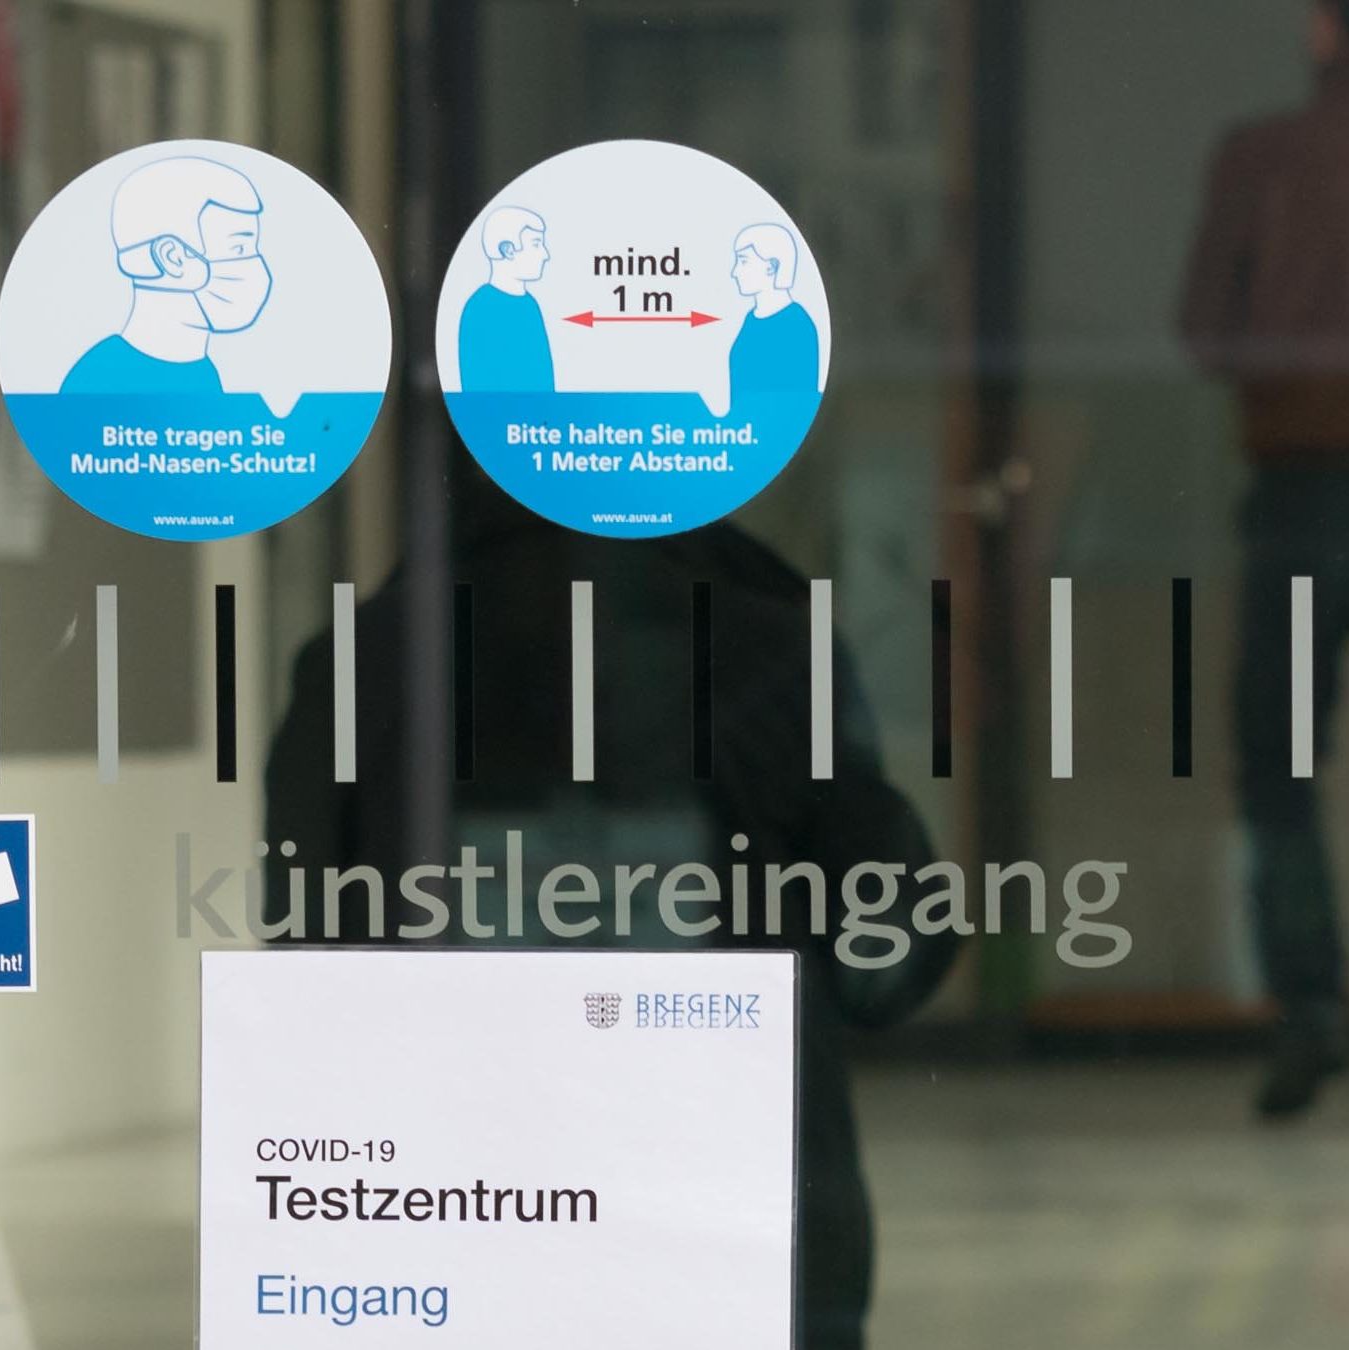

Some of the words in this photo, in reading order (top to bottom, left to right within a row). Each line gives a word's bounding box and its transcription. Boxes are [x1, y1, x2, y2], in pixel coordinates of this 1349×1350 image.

[593, 247, 692, 278] mind.
[612, 286, 628, 313] 1
[642, 291, 674, 313] m
[103, 426, 158, 447] Bitte
[165, 427, 243, 451] tragen
[251, 425, 286, 446] Sie
[507, 424, 562, 445] Bitte
[569, 424, 643, 445] halten
[651, 424, 686, 445] Sie
[692, 423, 759, 445] mind.
[71, 453, 316, 474] Mund-Nasen-Schutz!
[531, 452, 543, 471] 1
[552, 452, 622, 471] Meter
[629, 451, 734, 472] Abstand.
[153, 515, 235, 526] www.auva.at
[592, 512, 673, 523] www.auva.at
[176, 830, 1133, 969] künstlereingang
[636, 993, 760, 1017] BREGENZ
[256, 1138, 396, 1163] COVID-19
[256, 1176, 599, 1223] Testzentrum
[256, 1275, 449, 1326] Eingang
